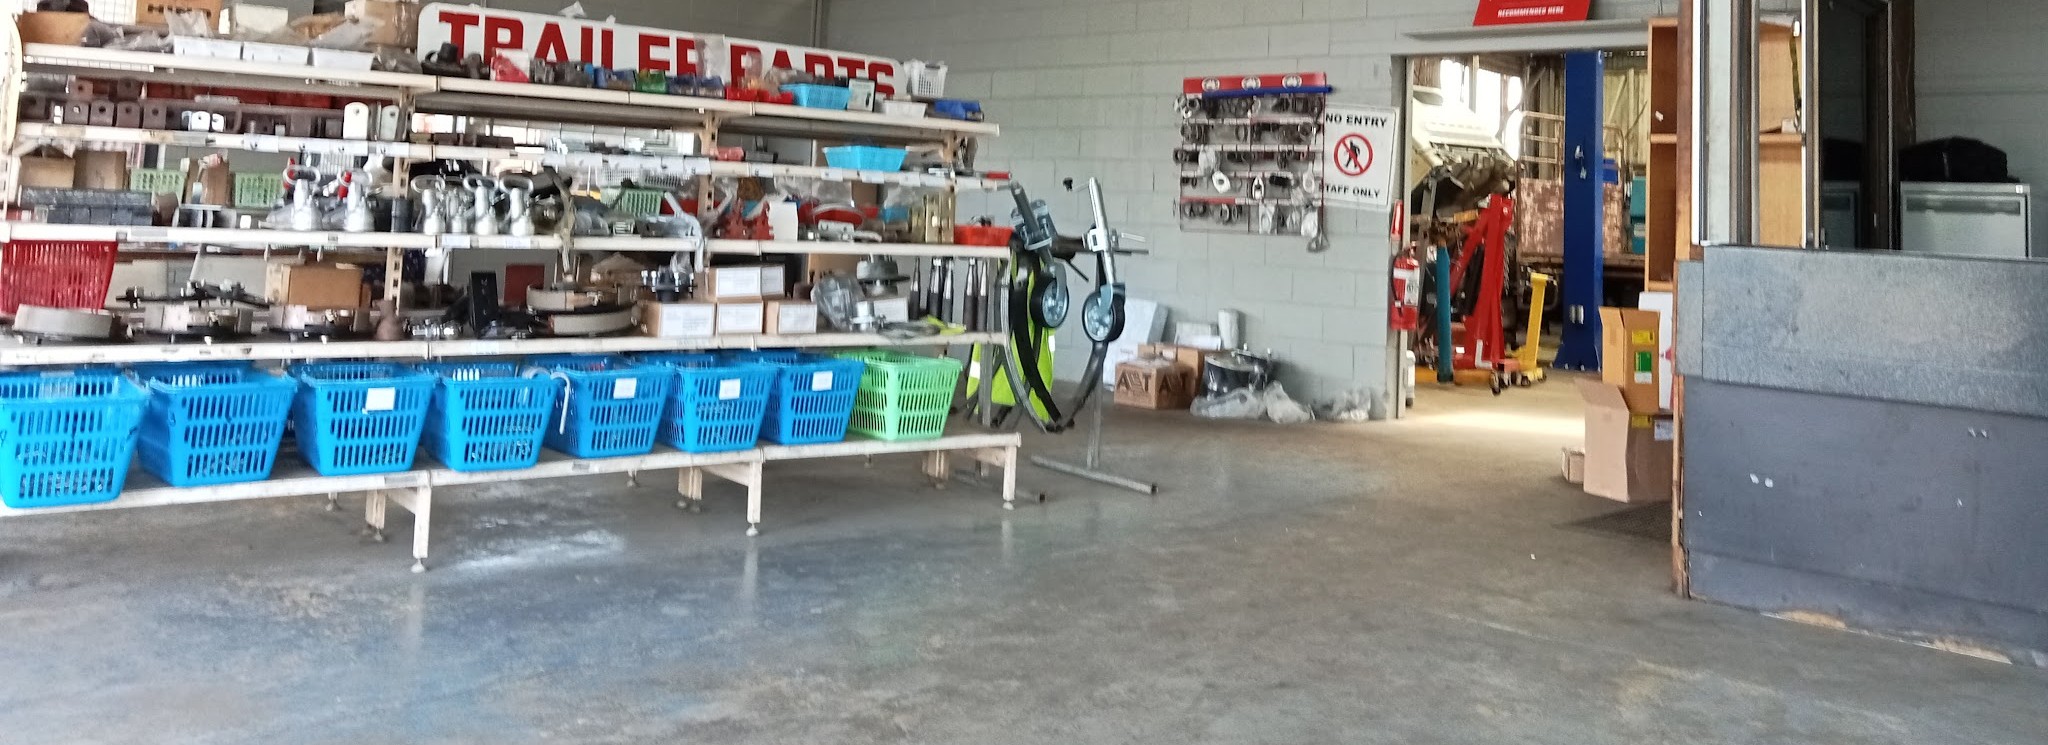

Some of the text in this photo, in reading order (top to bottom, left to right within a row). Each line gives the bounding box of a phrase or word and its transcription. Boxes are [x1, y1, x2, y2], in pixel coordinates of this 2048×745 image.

[1497, 5, 1564, 18] RECOMMENDED HERE
[1325, 113, 1387, 128] NO ENTRY
[1320, 183, 1380, 198] TAFF ONLY
